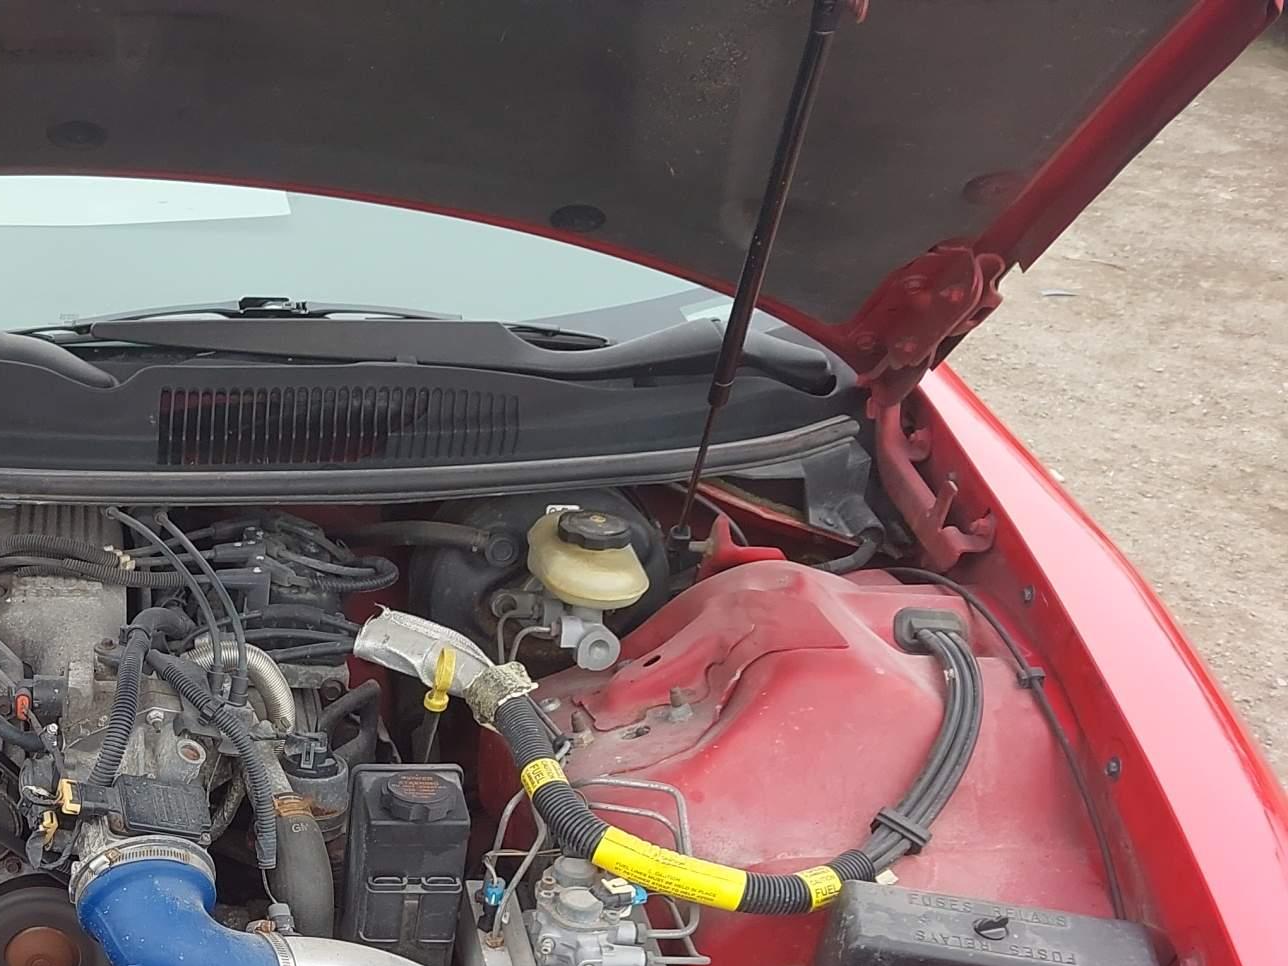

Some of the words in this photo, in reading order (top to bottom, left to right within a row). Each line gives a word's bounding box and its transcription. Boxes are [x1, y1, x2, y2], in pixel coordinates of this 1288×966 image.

[529, 763, 545, 785] FUEL
[815, 884, 838, 899] FUEL
[907, 893, 975, 914] FUSES
[991, 906, 1067, 928] RELAYS
[914, 930, 991, 952] RELAYS
[1008, 943, 1078, 966] FUSES
